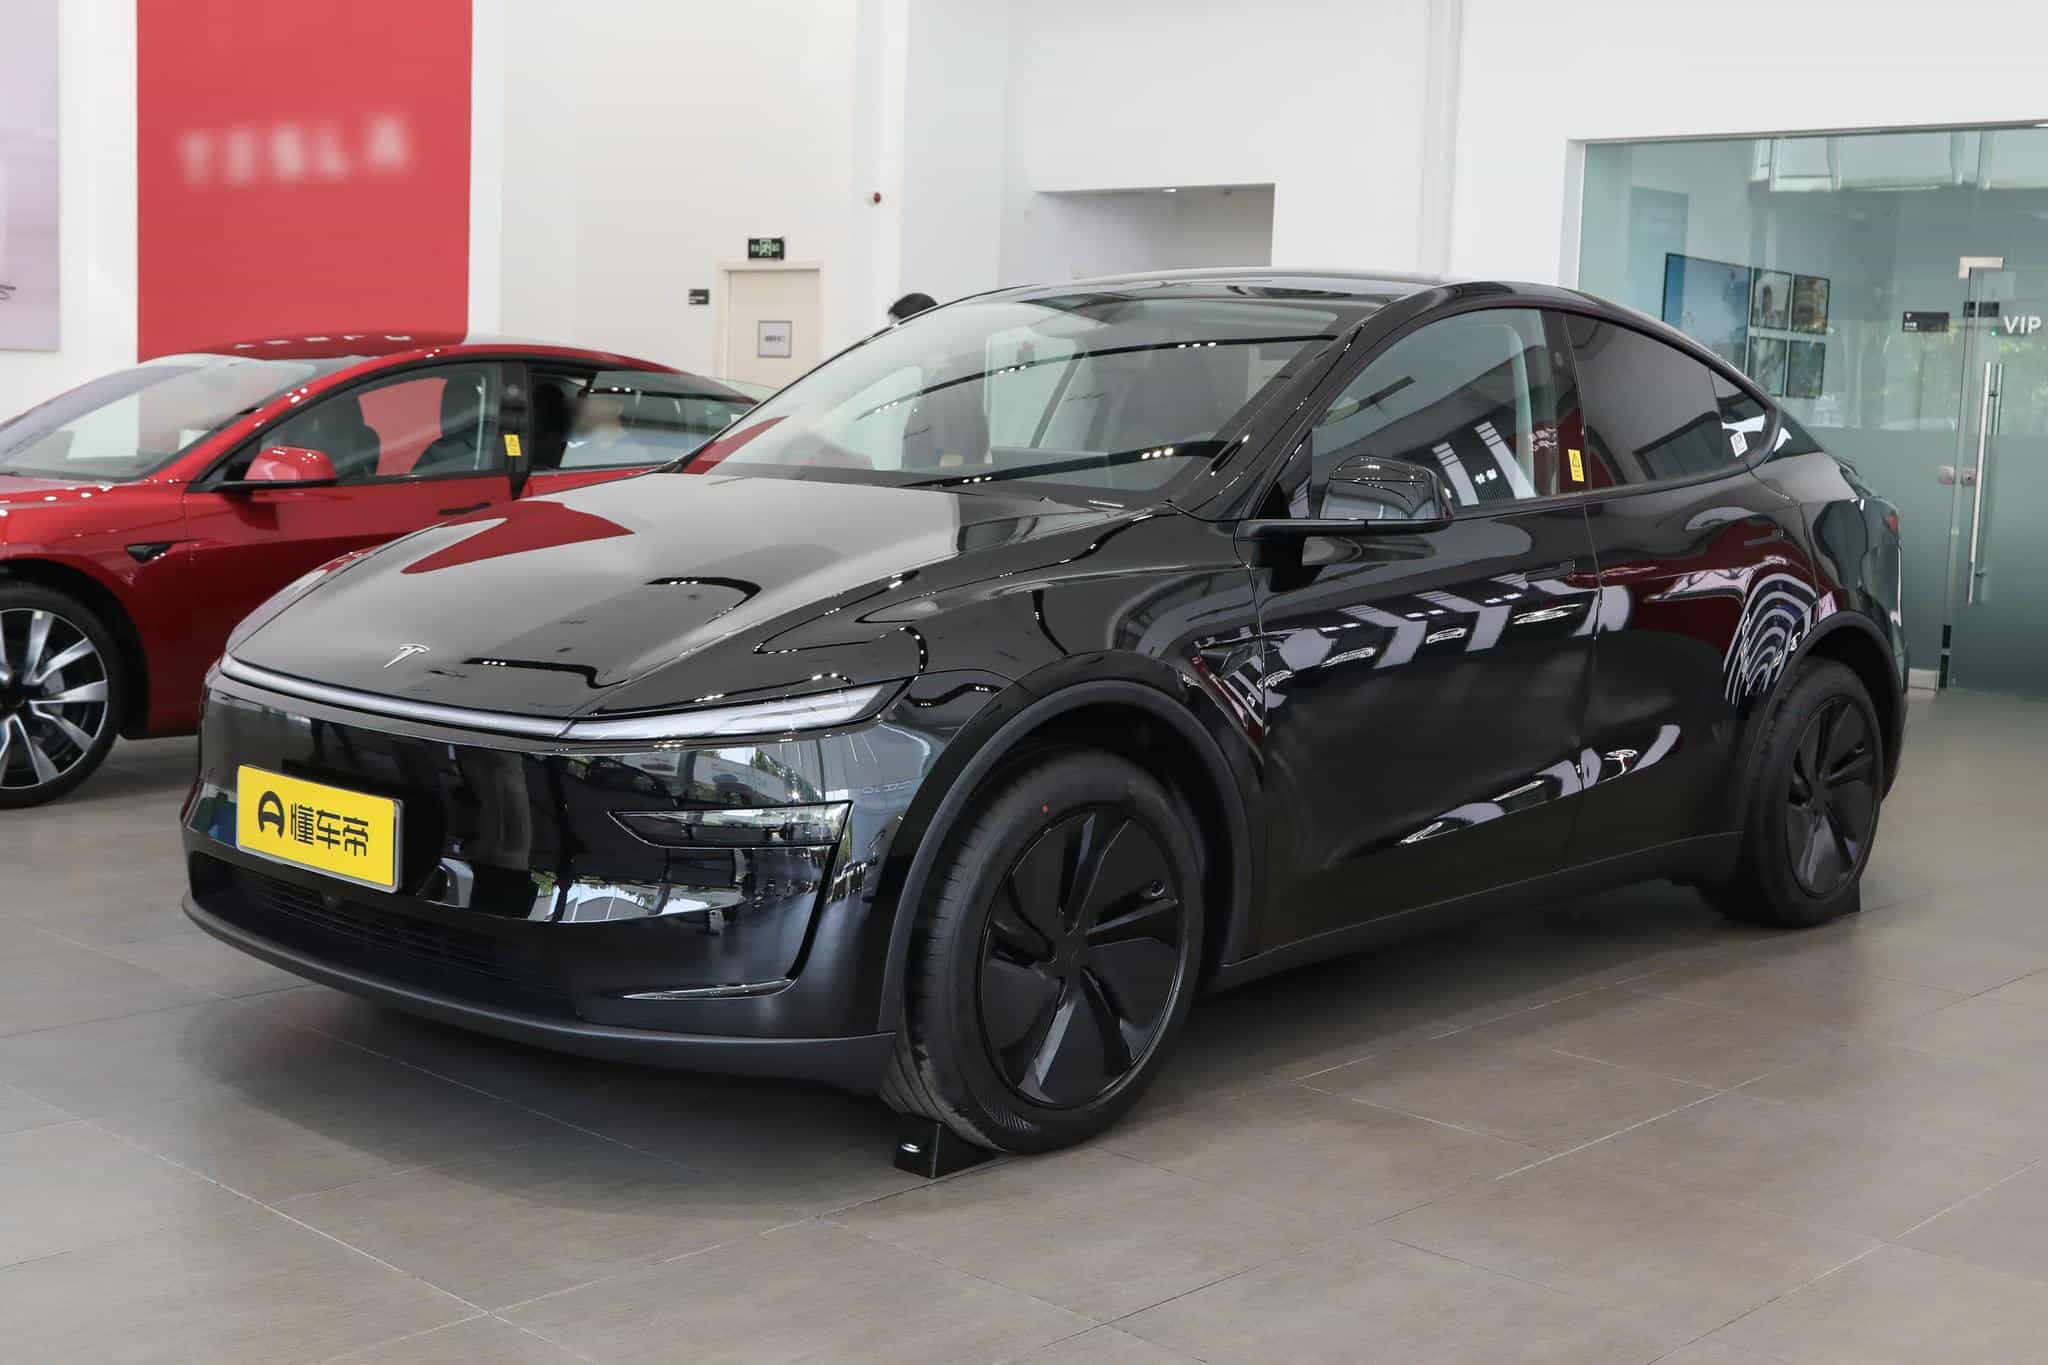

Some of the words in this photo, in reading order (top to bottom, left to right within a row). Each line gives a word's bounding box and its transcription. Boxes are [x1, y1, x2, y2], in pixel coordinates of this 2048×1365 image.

[2003, 316, 2042, 334] VIP
[290, 802, 369, 857] 懂车帝
